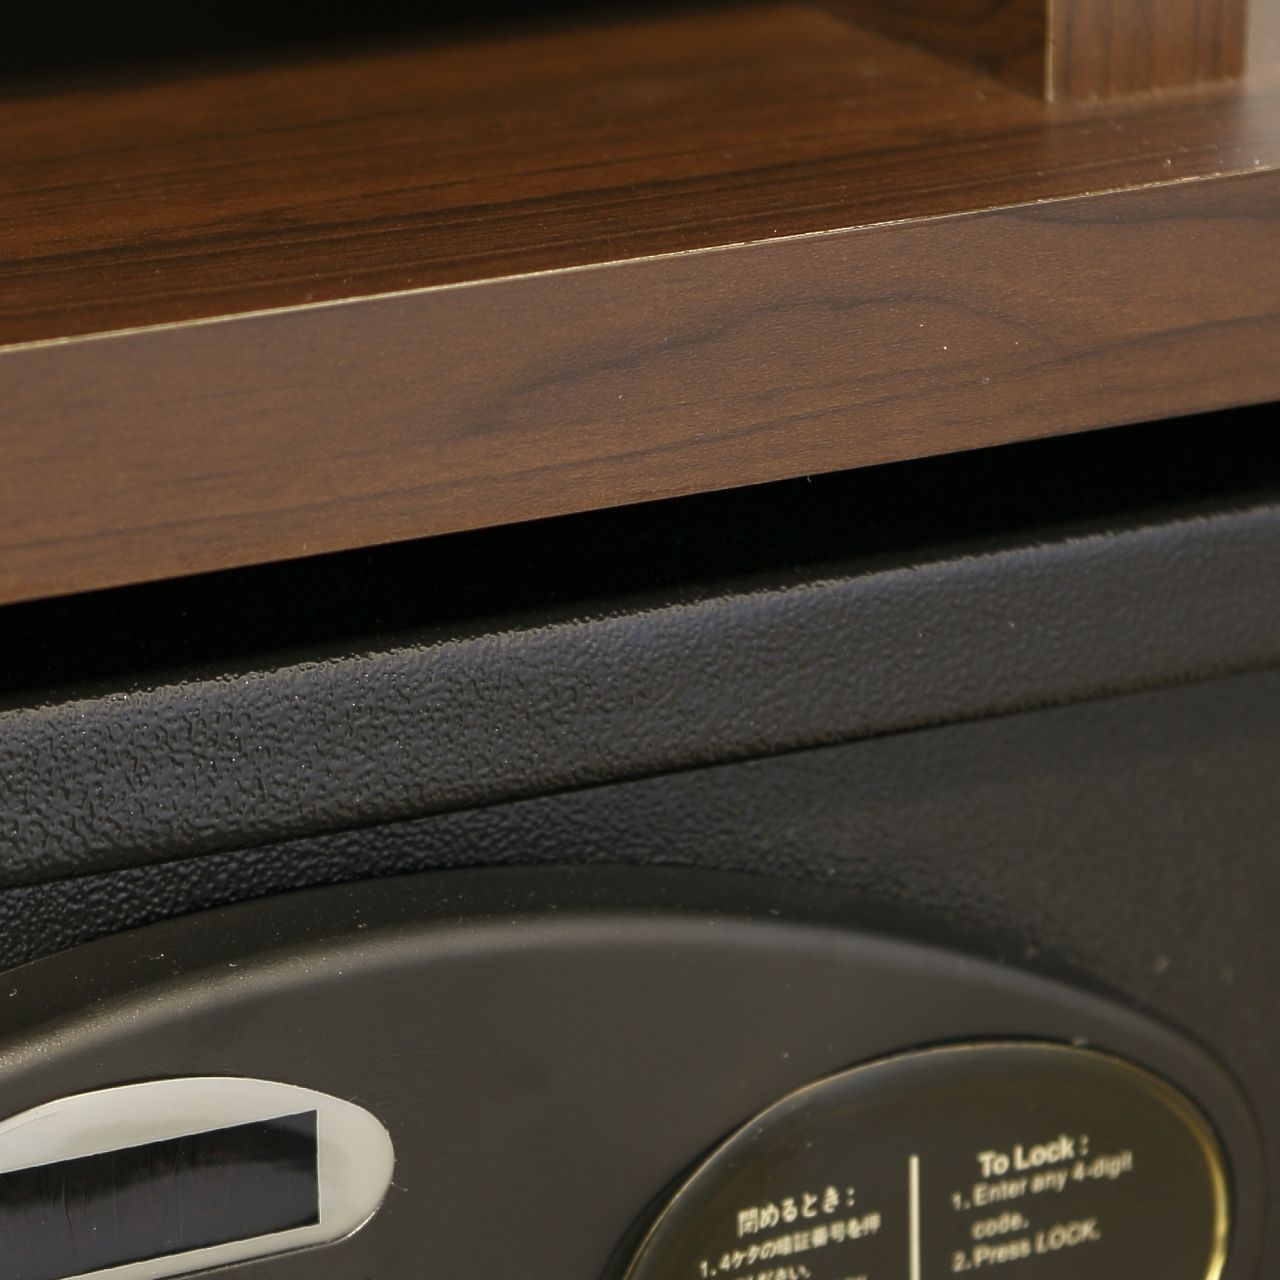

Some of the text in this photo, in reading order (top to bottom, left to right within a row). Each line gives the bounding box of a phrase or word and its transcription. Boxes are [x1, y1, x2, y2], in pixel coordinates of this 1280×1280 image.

[978, 1151, 1010, 1178] To
[1014, 1134, 1075, 1171] Lock
[973, 1177, 1026, 1207] Enter
[1030, 1168, 1068, 1192] any
[1072, 1150, 1133, 1182] 4-digit
[972, 1238, 1031, 1268] Press
